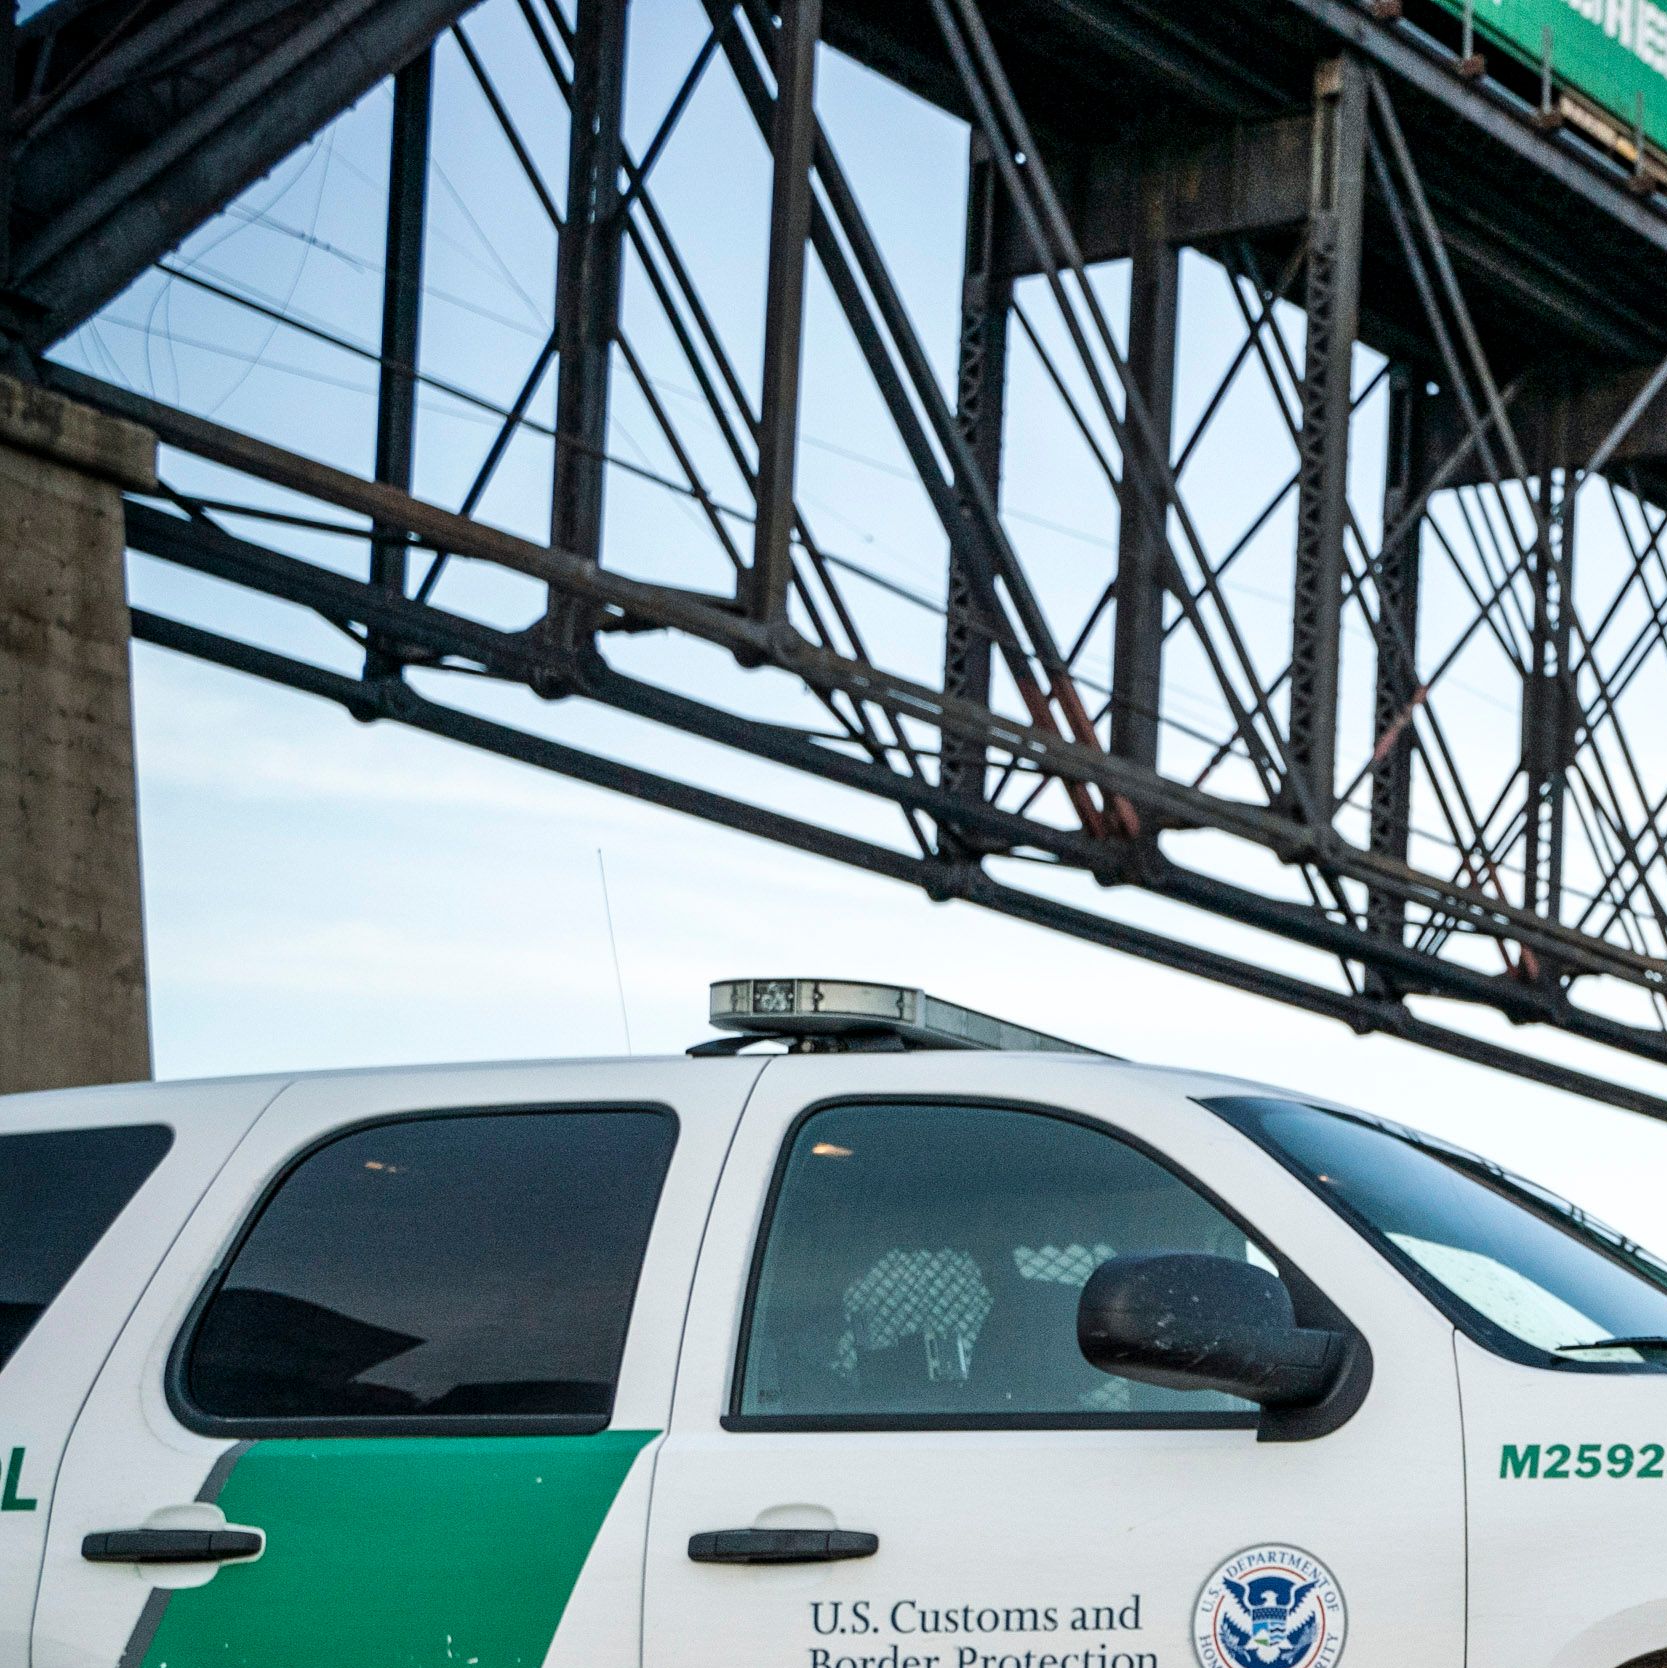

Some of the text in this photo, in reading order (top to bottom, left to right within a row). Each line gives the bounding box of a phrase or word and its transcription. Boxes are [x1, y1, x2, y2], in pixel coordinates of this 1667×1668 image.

[1226, 1551, 1329, 1588] DEPARTMENT
[1325, 1592, 1340, 1613] OF
[809, 1593, 1143, 1636] U.S. Customs and
